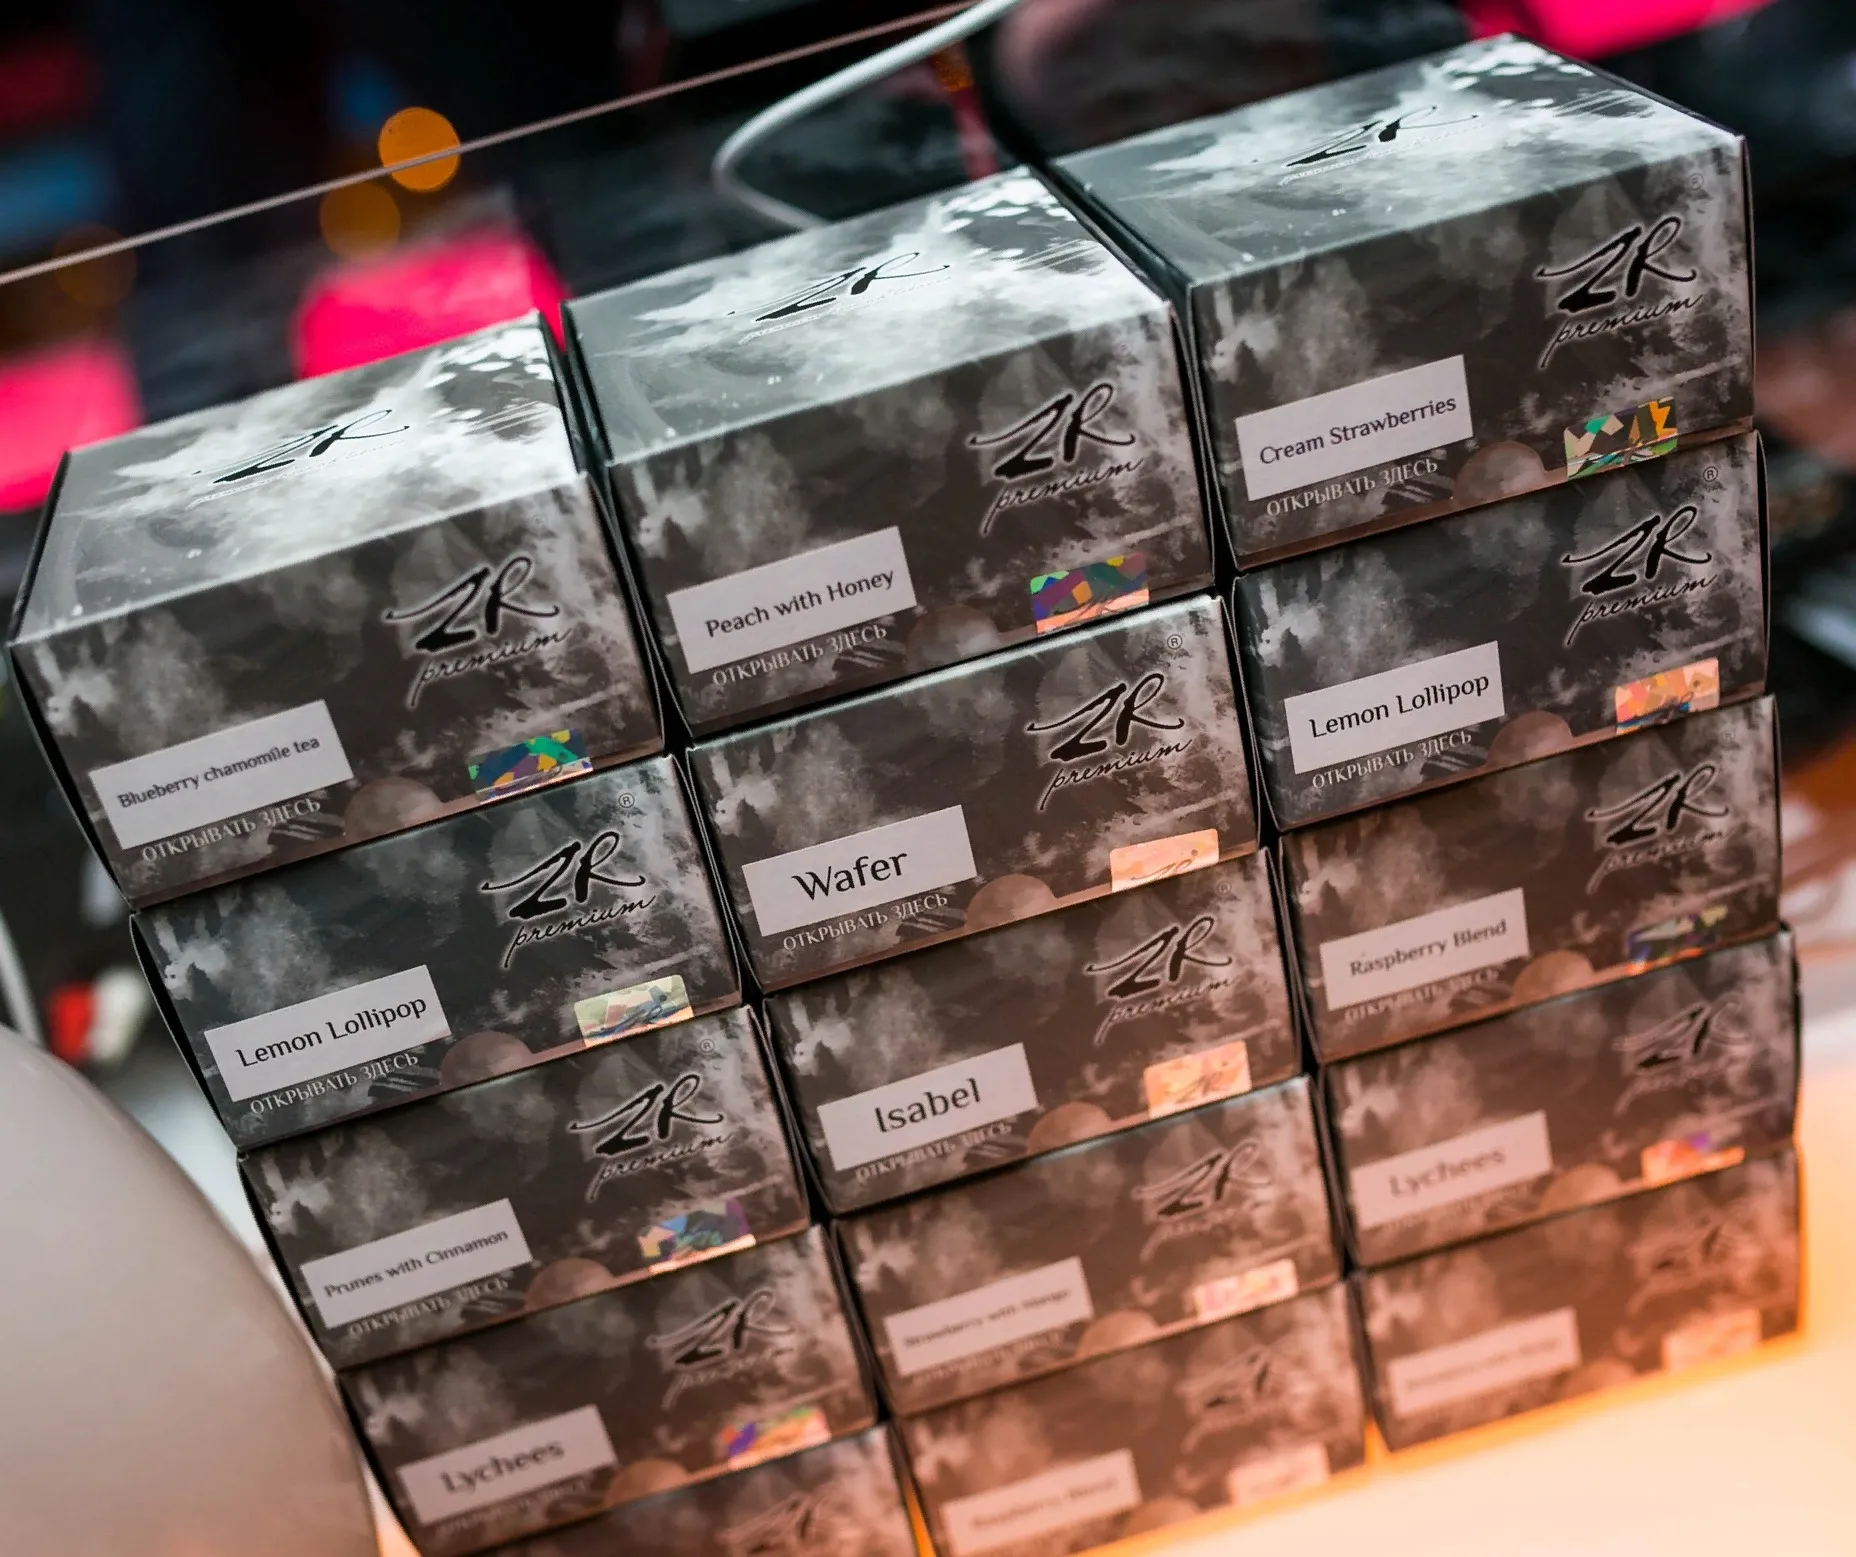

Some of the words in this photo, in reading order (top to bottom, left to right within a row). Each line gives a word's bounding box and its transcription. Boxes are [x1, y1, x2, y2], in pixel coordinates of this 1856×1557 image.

[1538, 293, 1704, 369] premium
[1258, 432, 1326, 465] Cream
[1329, 395, 1457, 445] Strawberries
[980, 456, 1145, 537] premium
[1266, 475, 1376, 517] ОТКРЫВАТЬ
[704, 602, 771, 639] Peach
[773, 585, 822, 618] with
[825, 566, 895, 606] Honey
[1564, 572, 1718, 646] premium
[407, 627, 572, 708] premium
[711, 644, 824, 688] ОТКРЫВАТЬ
[1308, 700, 1390, 739] Lemon
[1394, 673, 1491, 716] Lollipop
[117, 771, 200, 809] Blueberry
[203, 745, 291, 785] chamomile
[293, 734, 320, 756] tea
[1037, 738, 1192, 811] premium
[1312, 747, 1416, 790] ОТКРЫВАТЬ
[141, 817, 257, 864] ОТКРЫВАТЬ
[792, 851, 908, 901] Wafer
[502, 894, 658, 970] premium
[783, 910, 890, 952] ОТКРЫВАТЬ
[1350, 939, 1447, 975] Raspberry
[1453, 918, 1507, 947] Blend
[236, 1024, 323, 1069] Lemon
[326, 996, 428, 1041] Lollipop
[250, 1070, 358, 1116] ОТКРЫВАТЬ
[874, 1077, 982, 1134] Isabel
[324, 1271, 384, 1298] Prunes
[385, 1257, 423, 1278] with
[425, 1230, 508, 1265] Cinnamon
[440, 1441, 565, 1494] Lychees
